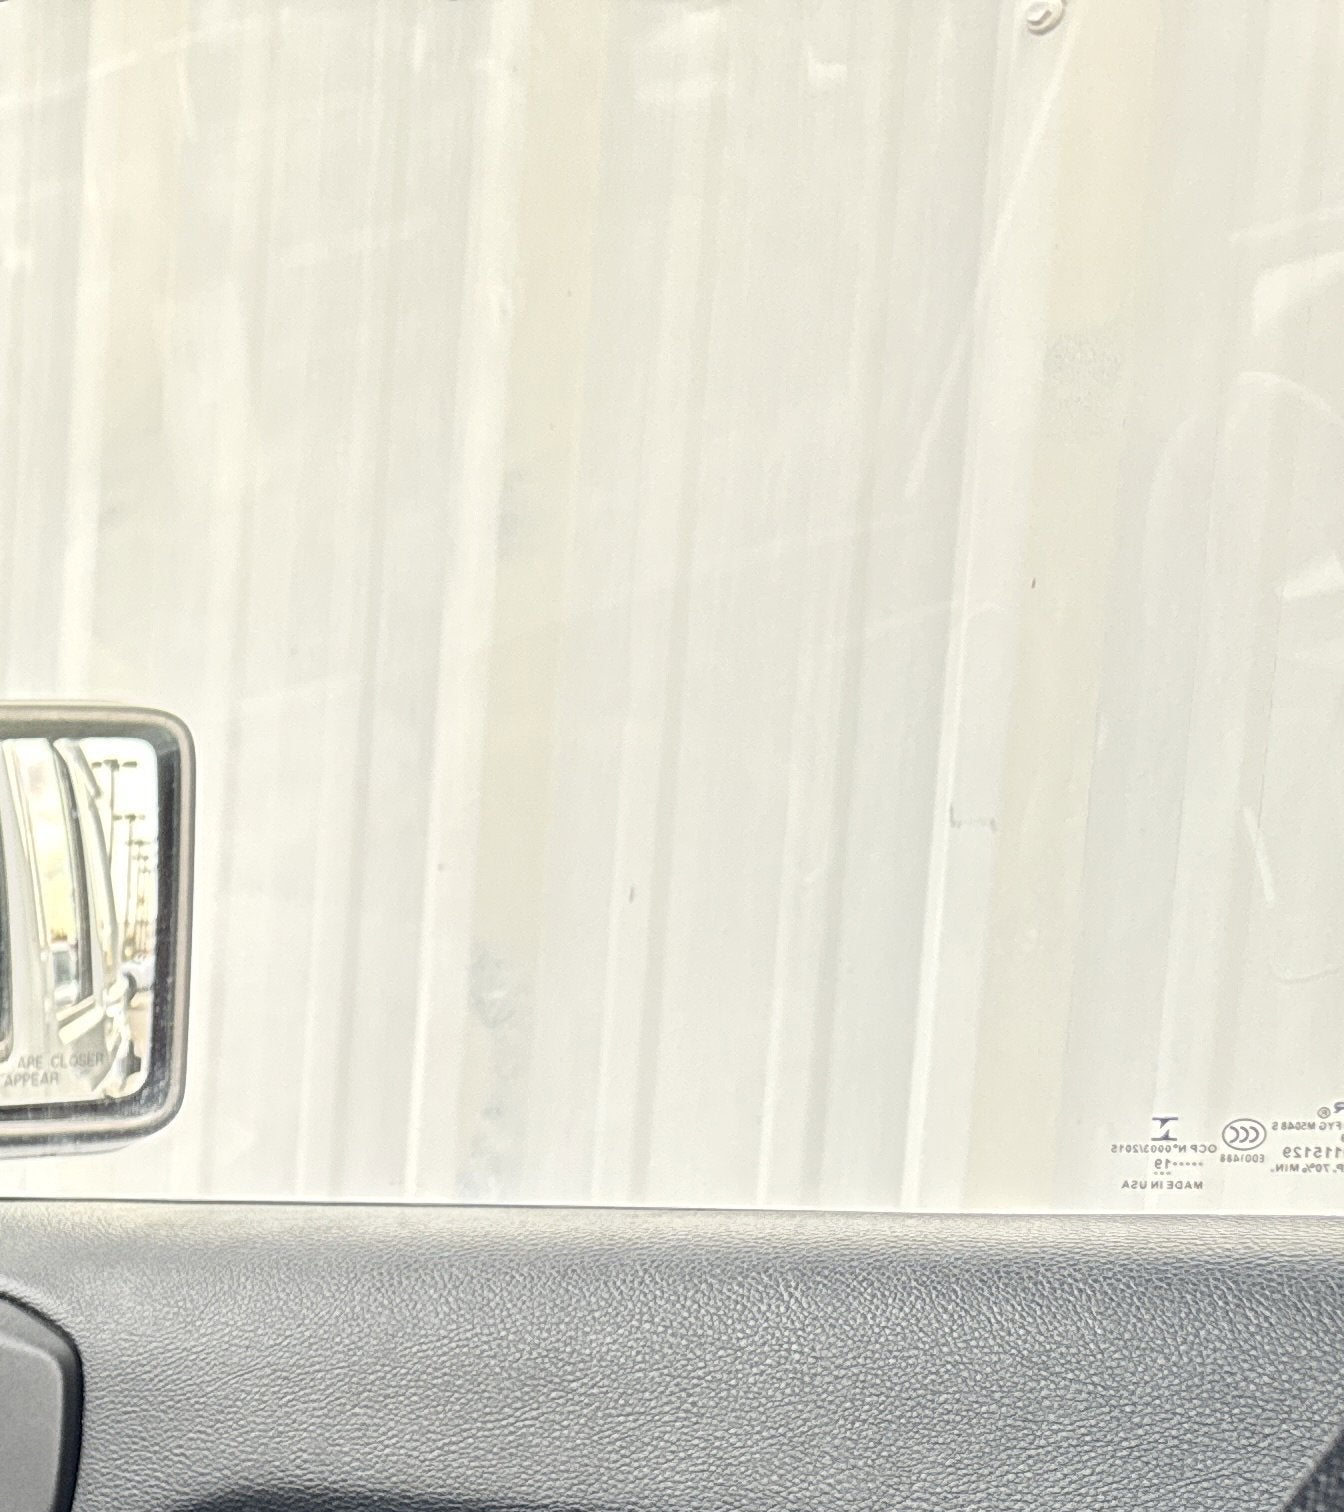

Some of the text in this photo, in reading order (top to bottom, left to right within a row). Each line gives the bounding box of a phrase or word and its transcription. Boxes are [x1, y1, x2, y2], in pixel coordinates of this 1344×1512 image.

[18, 1054, 43, 1069] ARE
[50, 1052, 104, 1069] CLOSER
[3, 1070, 59, 1087] APPEAR
